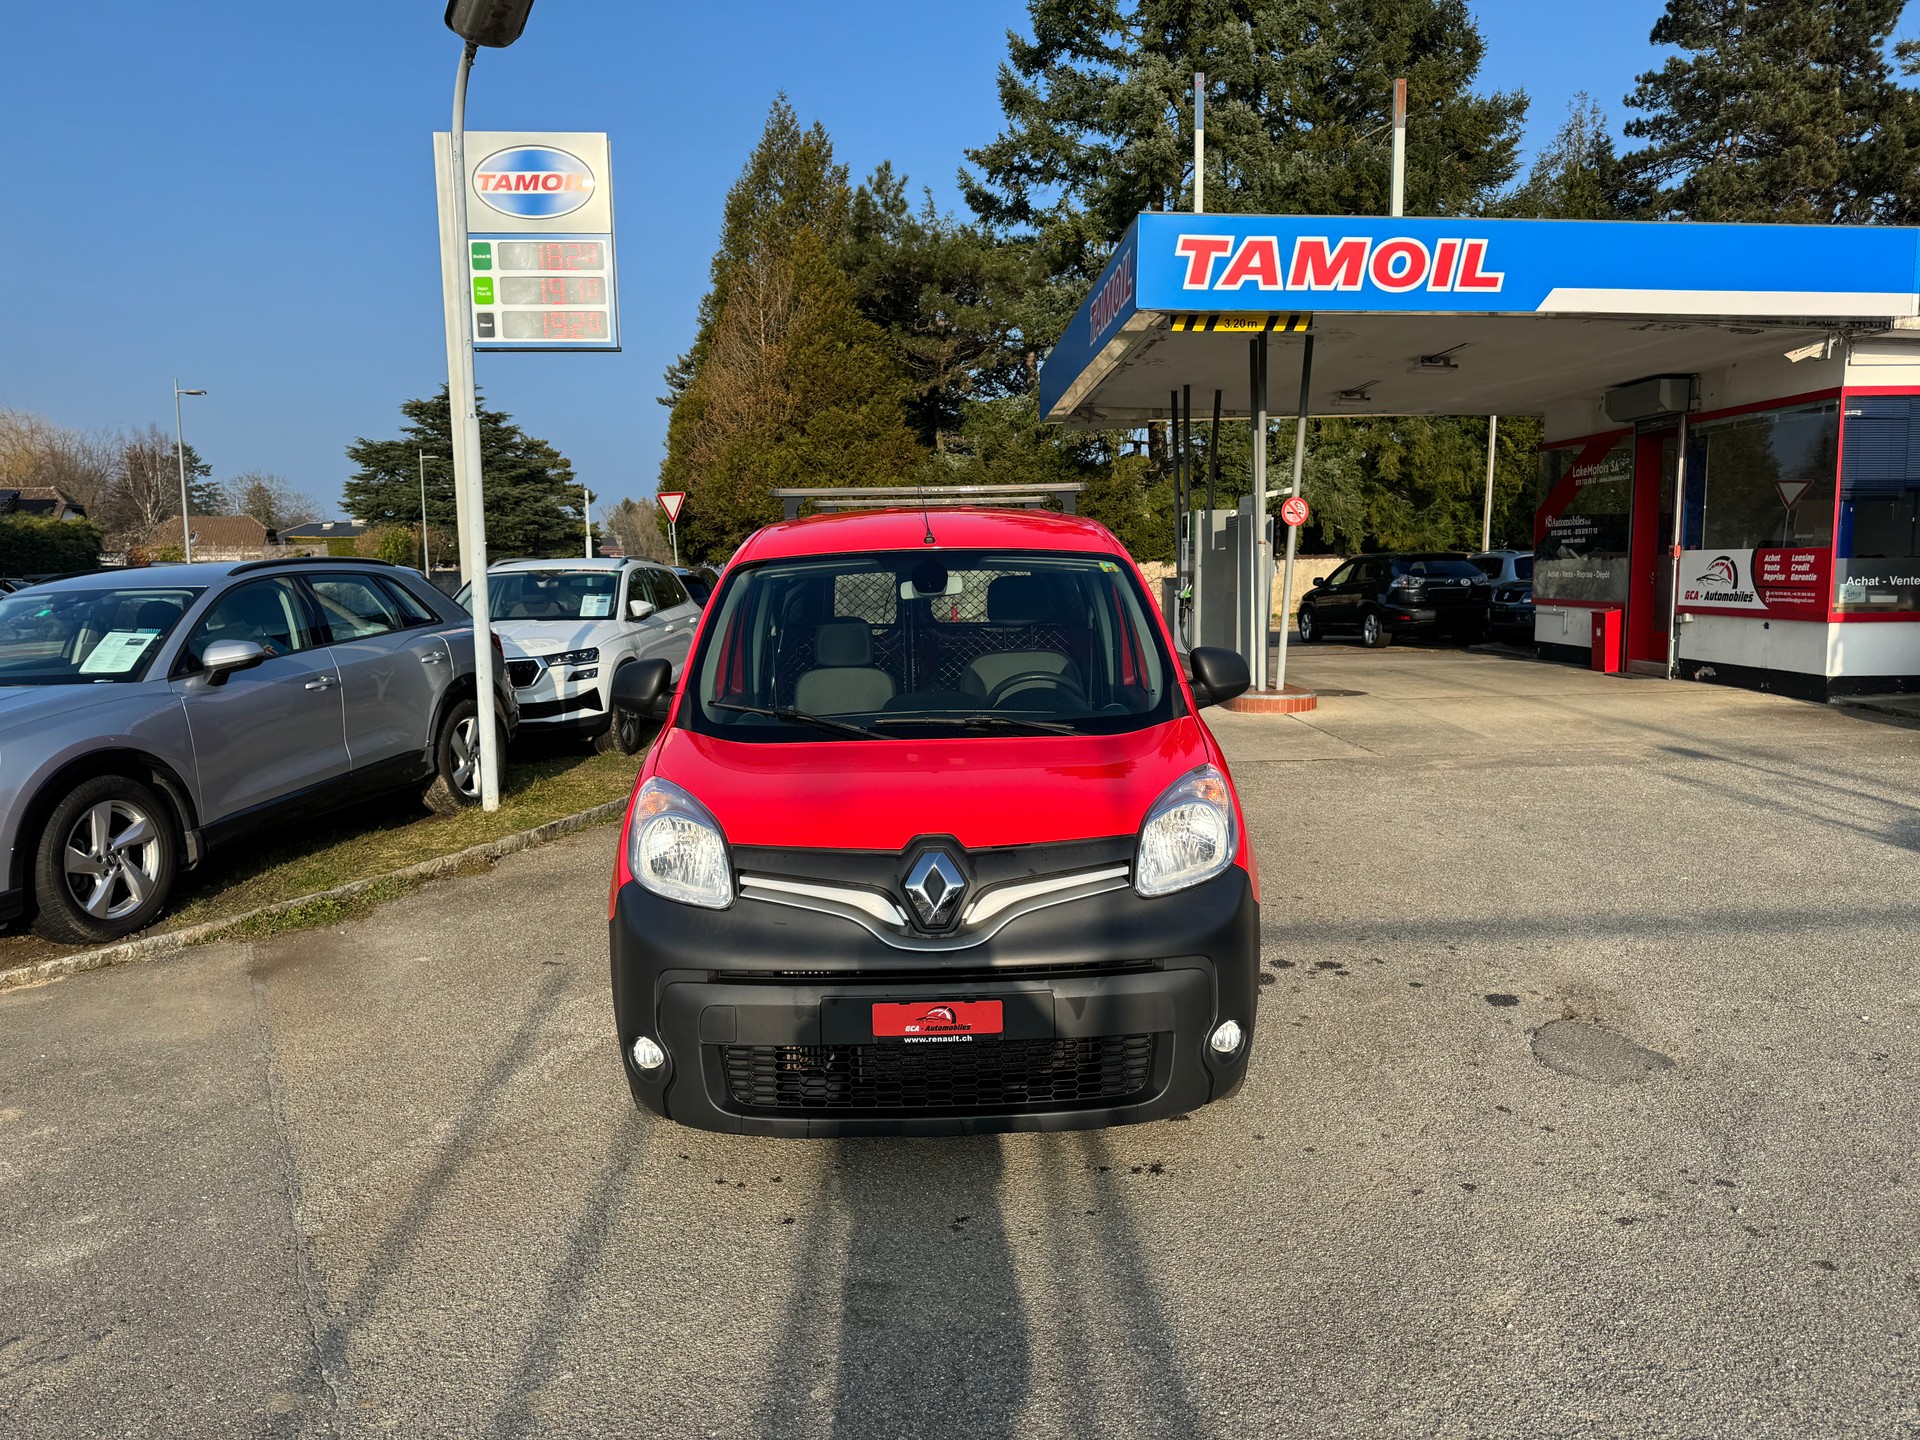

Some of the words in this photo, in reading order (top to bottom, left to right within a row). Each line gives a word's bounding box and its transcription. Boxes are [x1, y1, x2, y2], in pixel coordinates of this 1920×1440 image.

[477, 173, 592, 192] TAMOIL
[1174, 233, 1505, 293] TAMOIL
[1090, 246, 1132, 347] TAMOIL
[1223, 318, 1245, 328] 3.20
[1246, 320, 1257, 328] m
[1572, 463, 1609, 478] LakeMotors
[1610, 459, 1620, 472] SA
[1764, 554, 1781, 562] Achat
[1791, 553, 1815, 563] Leasing
[1764, 563, 1780, 572] Vente
[1577, 570, 1593, 580] Reprise
[1763, 573, 1786, 582] Reprise
[1790, 572, 1817, 581] Garantie
[1846, 576, 1880, 586] Achat
[1889, 575, 1920, 586] Vente
[1684, 590, 1699, 601] GCA
[1703, 590, 1754, 603] Automobiles
[925, 1024, 972, 1032] Automobiles
[904, 1035, 973, 1043] www.renault.ch
